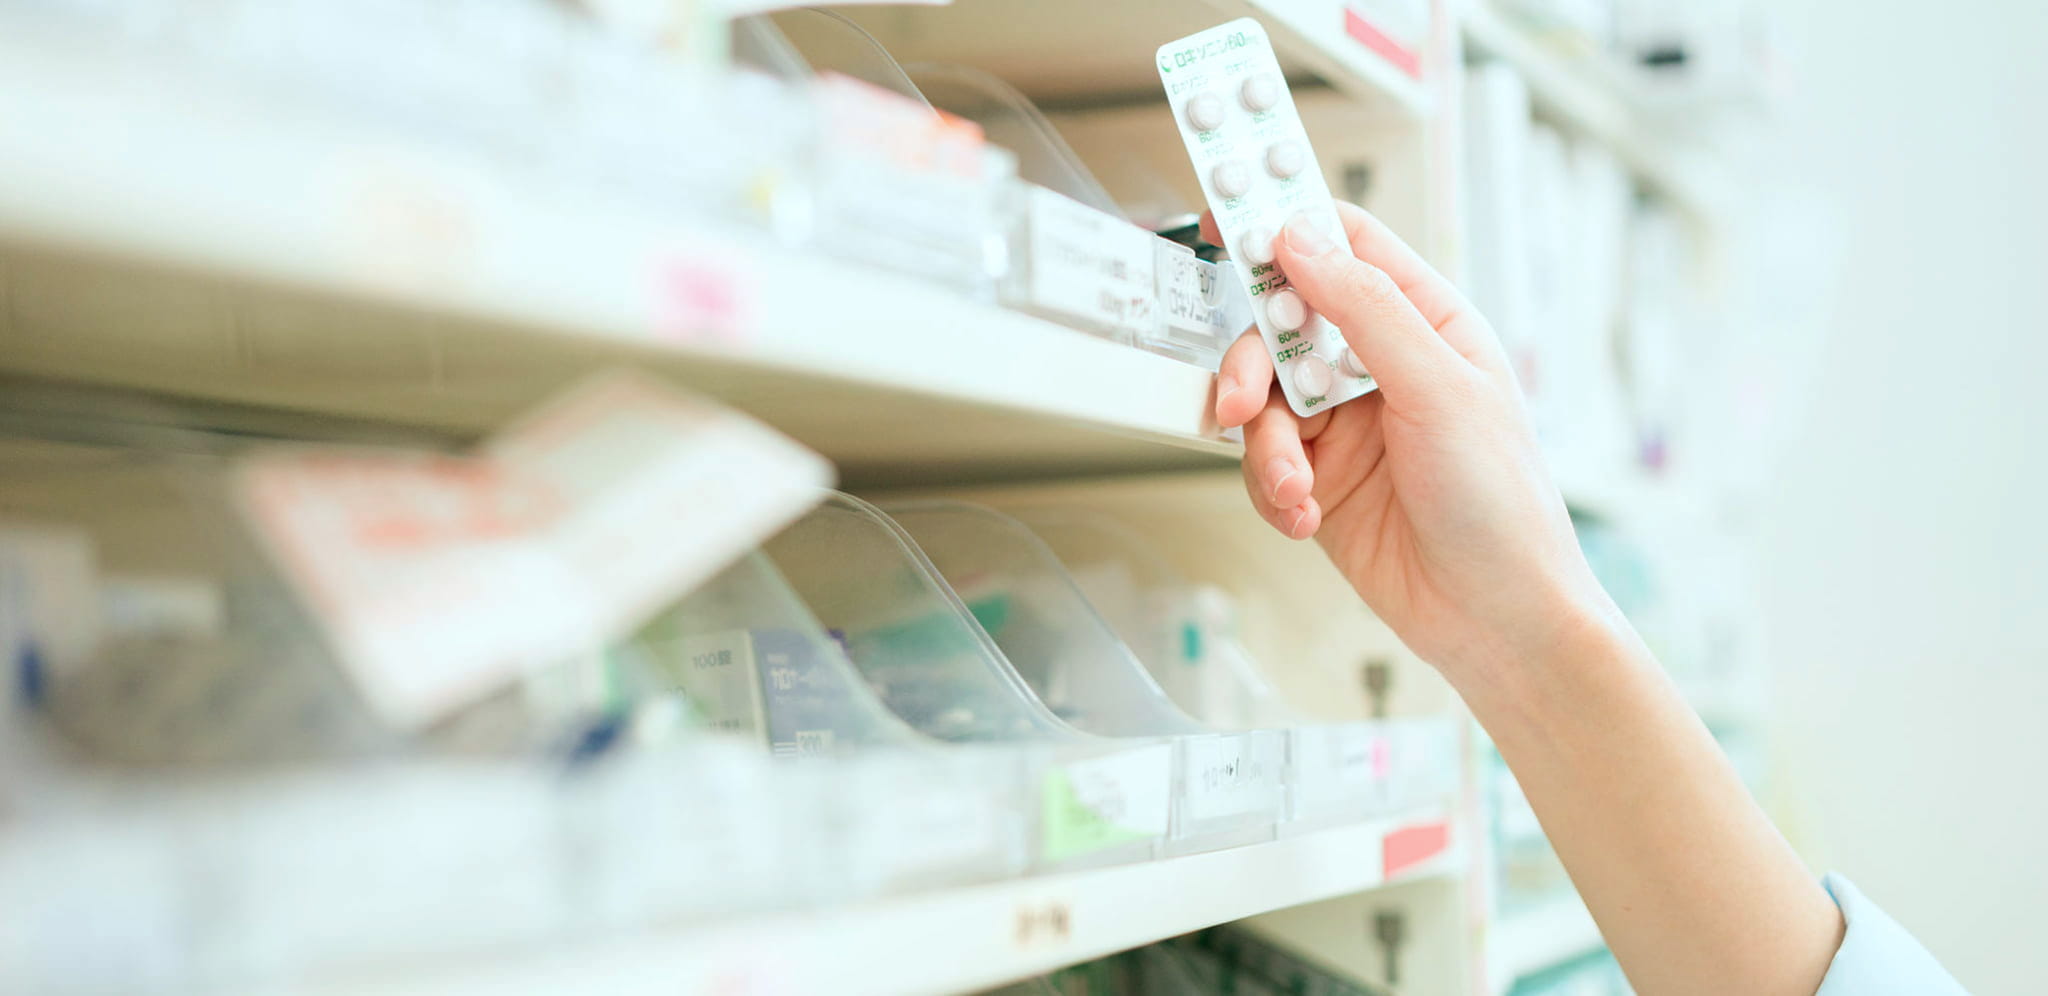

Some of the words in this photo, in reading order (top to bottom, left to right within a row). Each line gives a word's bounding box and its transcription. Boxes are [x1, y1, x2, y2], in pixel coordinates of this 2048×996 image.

[1249, 273, 1288, 297] ロキソニン
[1276, 340, 1315, 364] ロキソニン
